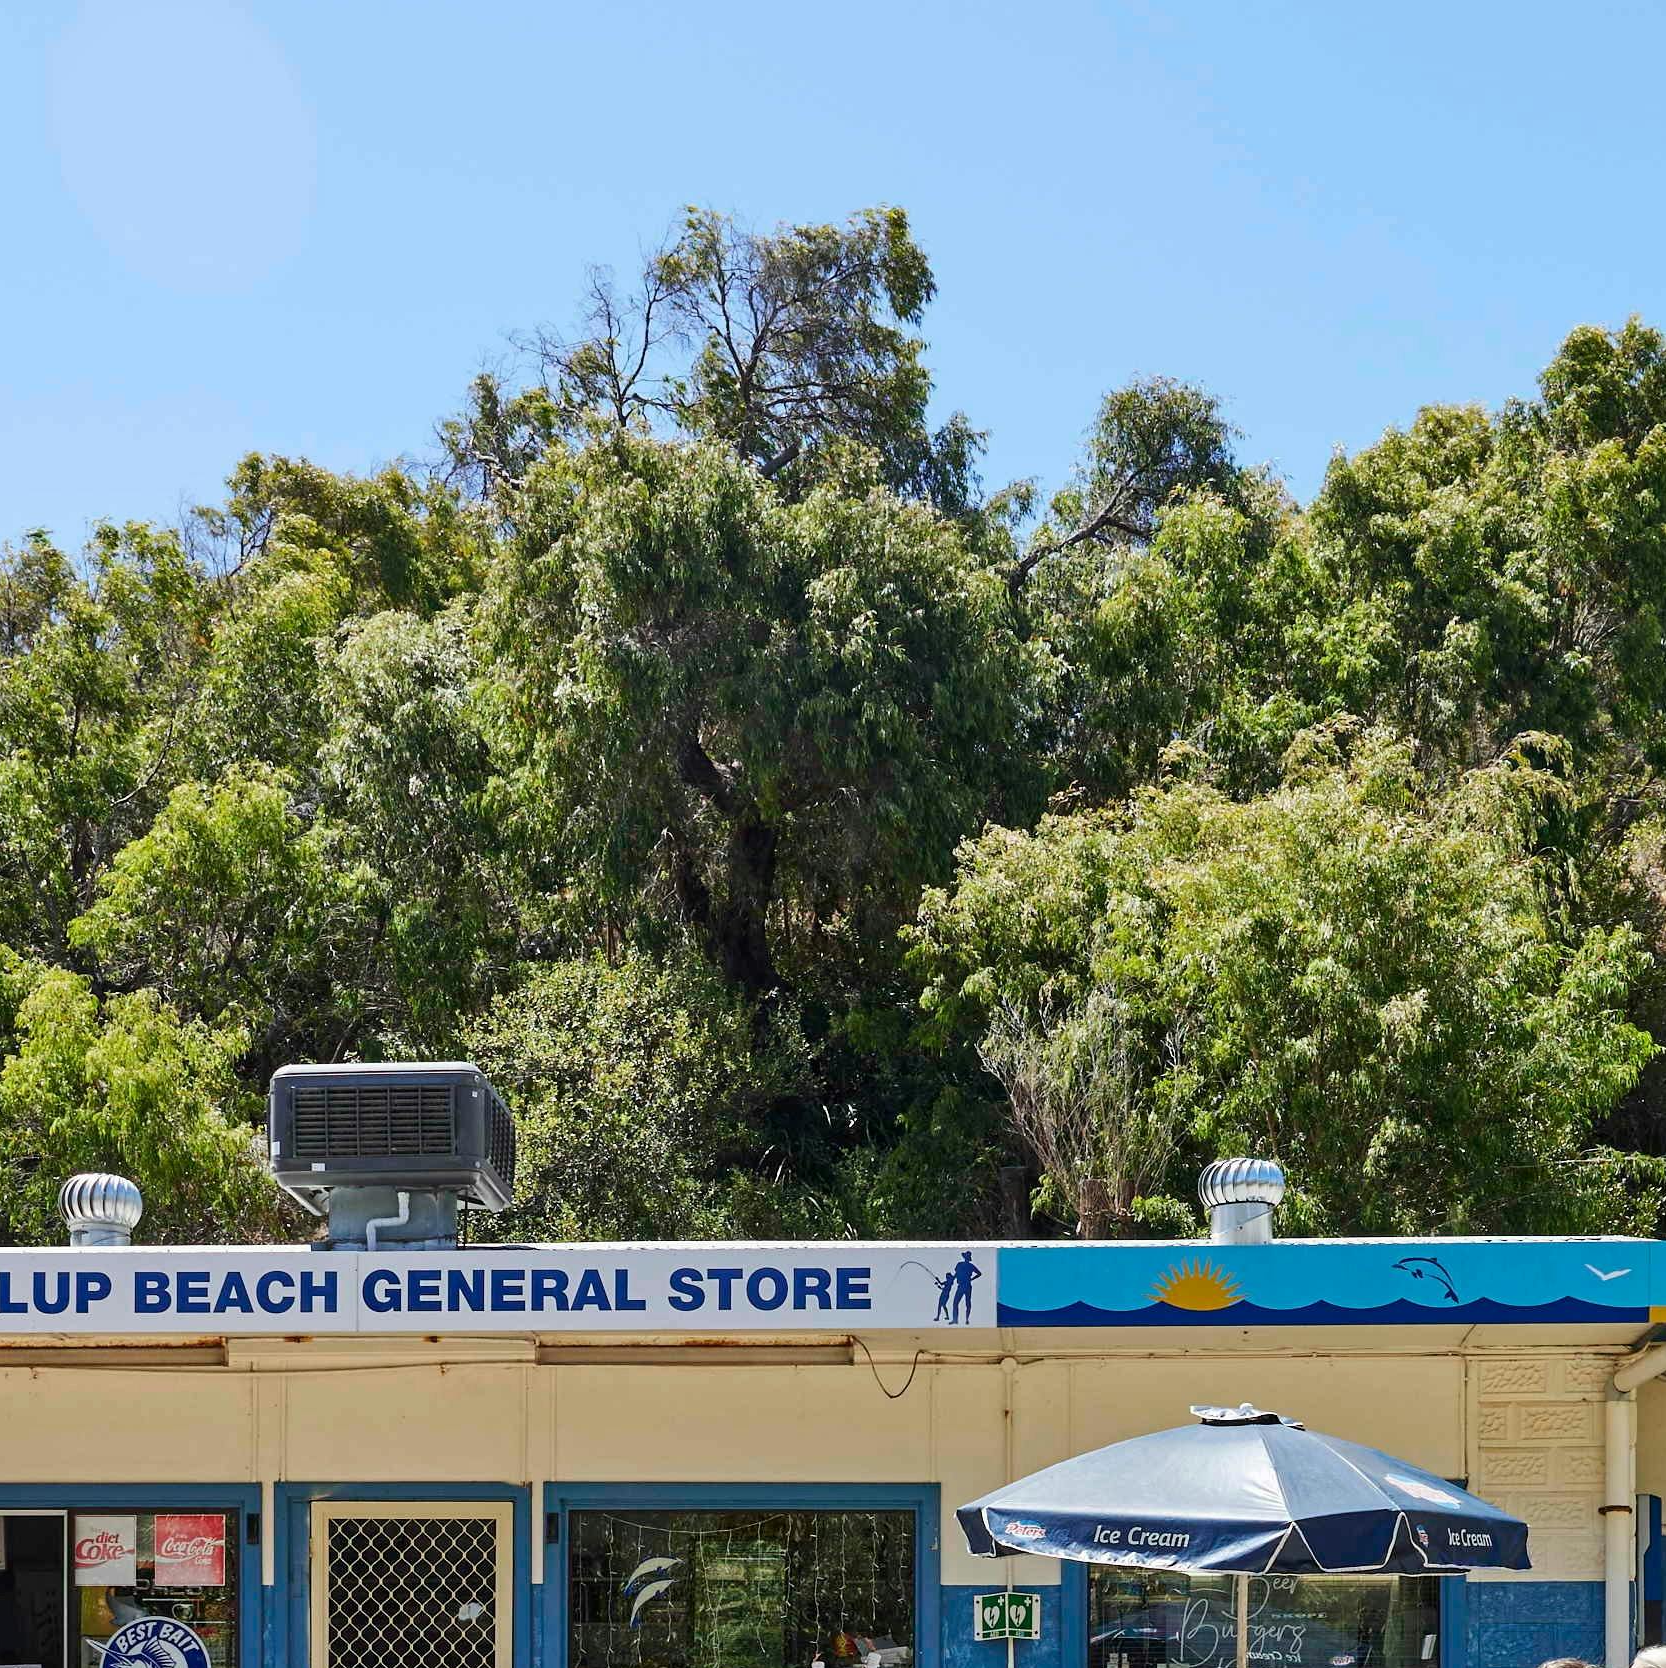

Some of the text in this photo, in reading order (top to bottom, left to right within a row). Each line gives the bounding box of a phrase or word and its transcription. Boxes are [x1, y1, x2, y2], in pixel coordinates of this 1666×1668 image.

[134, 1270, 338, 1314] BEACH
[362, 1268, 646, 1312] GENERAL
[667, 1266, 873, 1312] STORE
[96, 1532, 120, 1544] diet
[1094, 1524, 1190, 1548] Ice Cream
[1447, 1528, 1461, 1546] Ice
[1461, 1529, 1492, 1547] Cream
[75, 1538, 125, 1561] Coke
[116, 1621, 200, 1654] BEST BAIT
